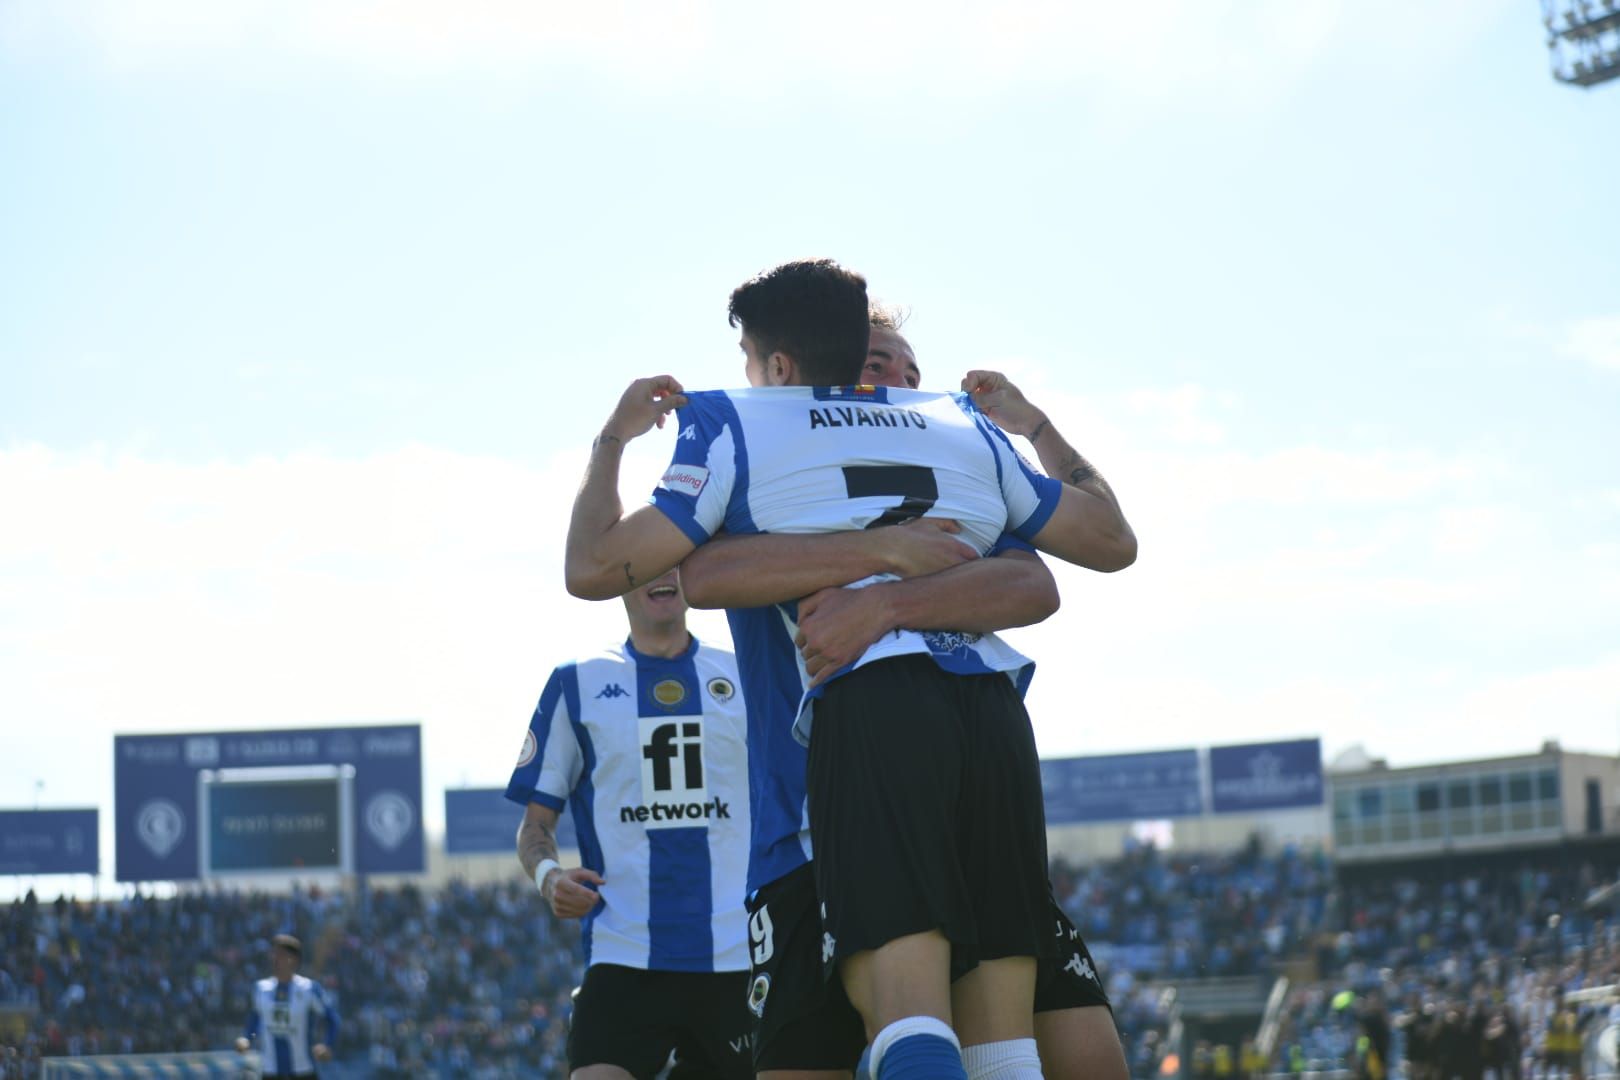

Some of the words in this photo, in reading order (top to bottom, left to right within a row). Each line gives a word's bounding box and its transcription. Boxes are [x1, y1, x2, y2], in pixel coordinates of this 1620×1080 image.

[809, 406, 927, 430] ALVARITO
[842, 465, 939, 529] 7
[643, 722, 703, 791] fi
[620, 796, 730, 823] network
[750, 903, 774, 965] 9
